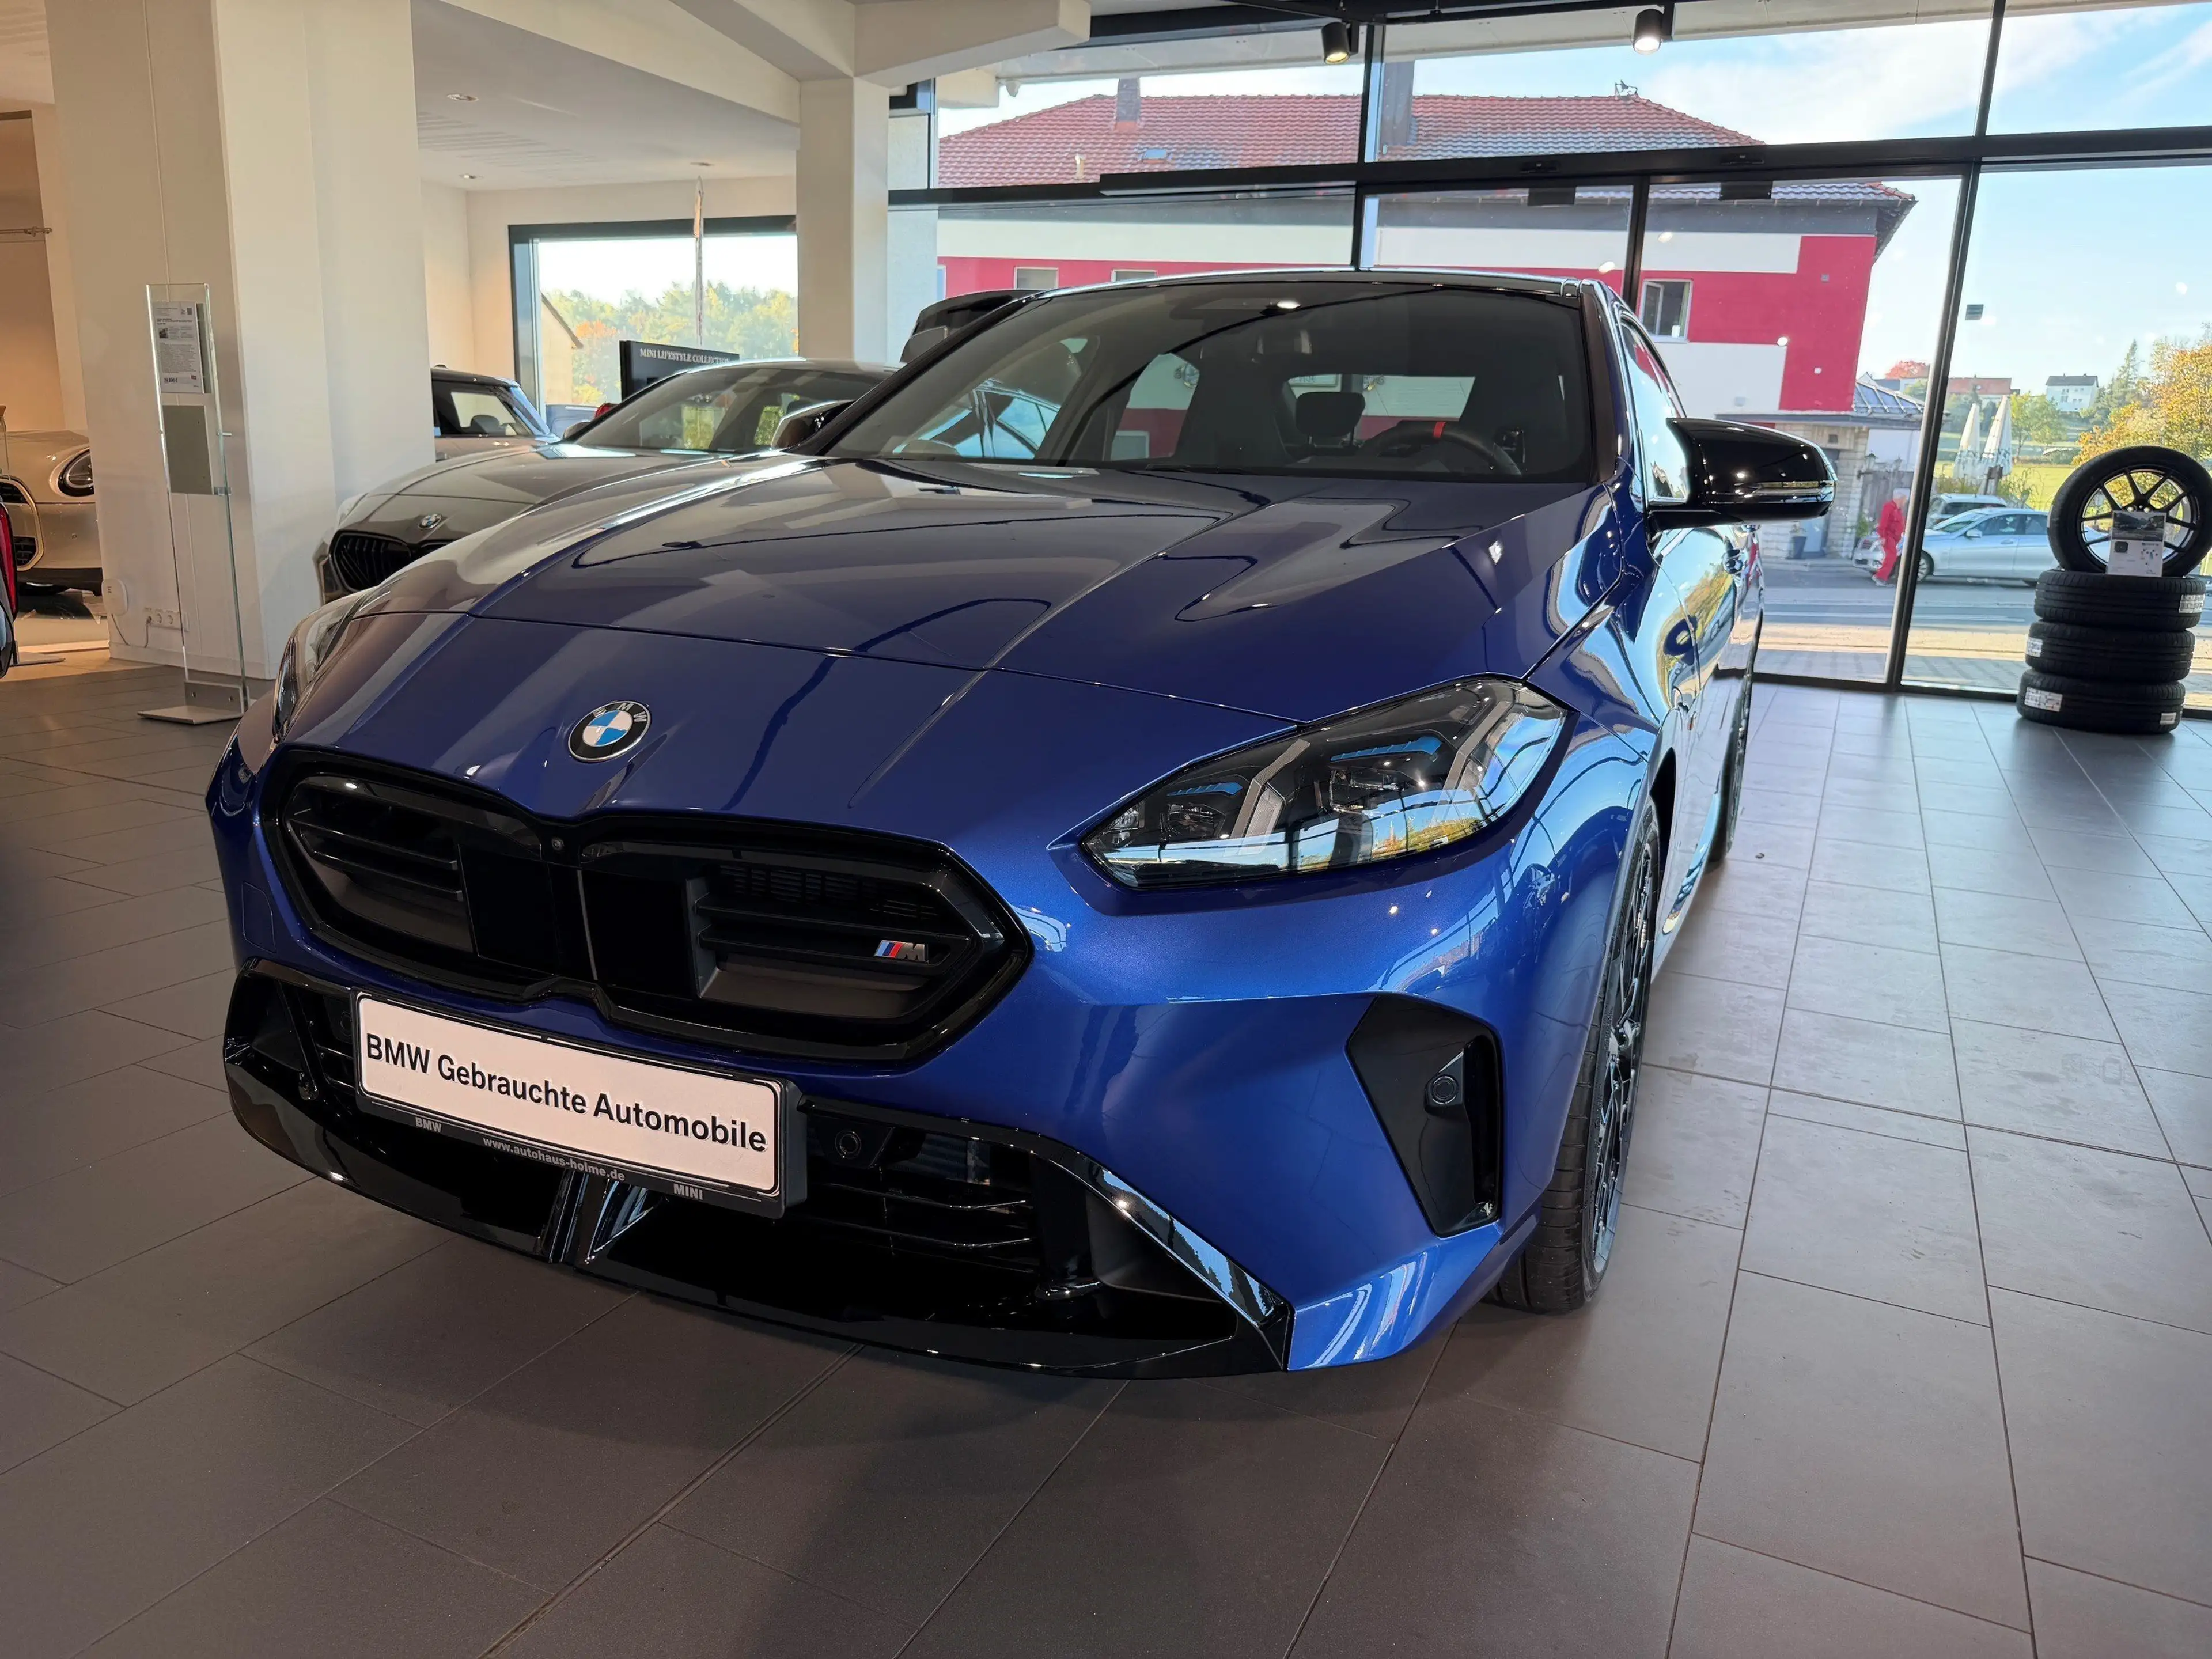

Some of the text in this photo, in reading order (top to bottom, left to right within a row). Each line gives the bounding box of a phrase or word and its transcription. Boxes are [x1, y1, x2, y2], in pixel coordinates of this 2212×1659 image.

[639, 347, 657, 358] MINI
[657, 349, 691, 362] LIFESTYLE
[593, 702, 647, 722] BMW
[893, 941, 925, 962] M
[366, 1032, 767, 1152] BMW Gebrauchte Automobile
[415, 1116, 704, 1200] BMW www.autohaus-holme.de MINI
